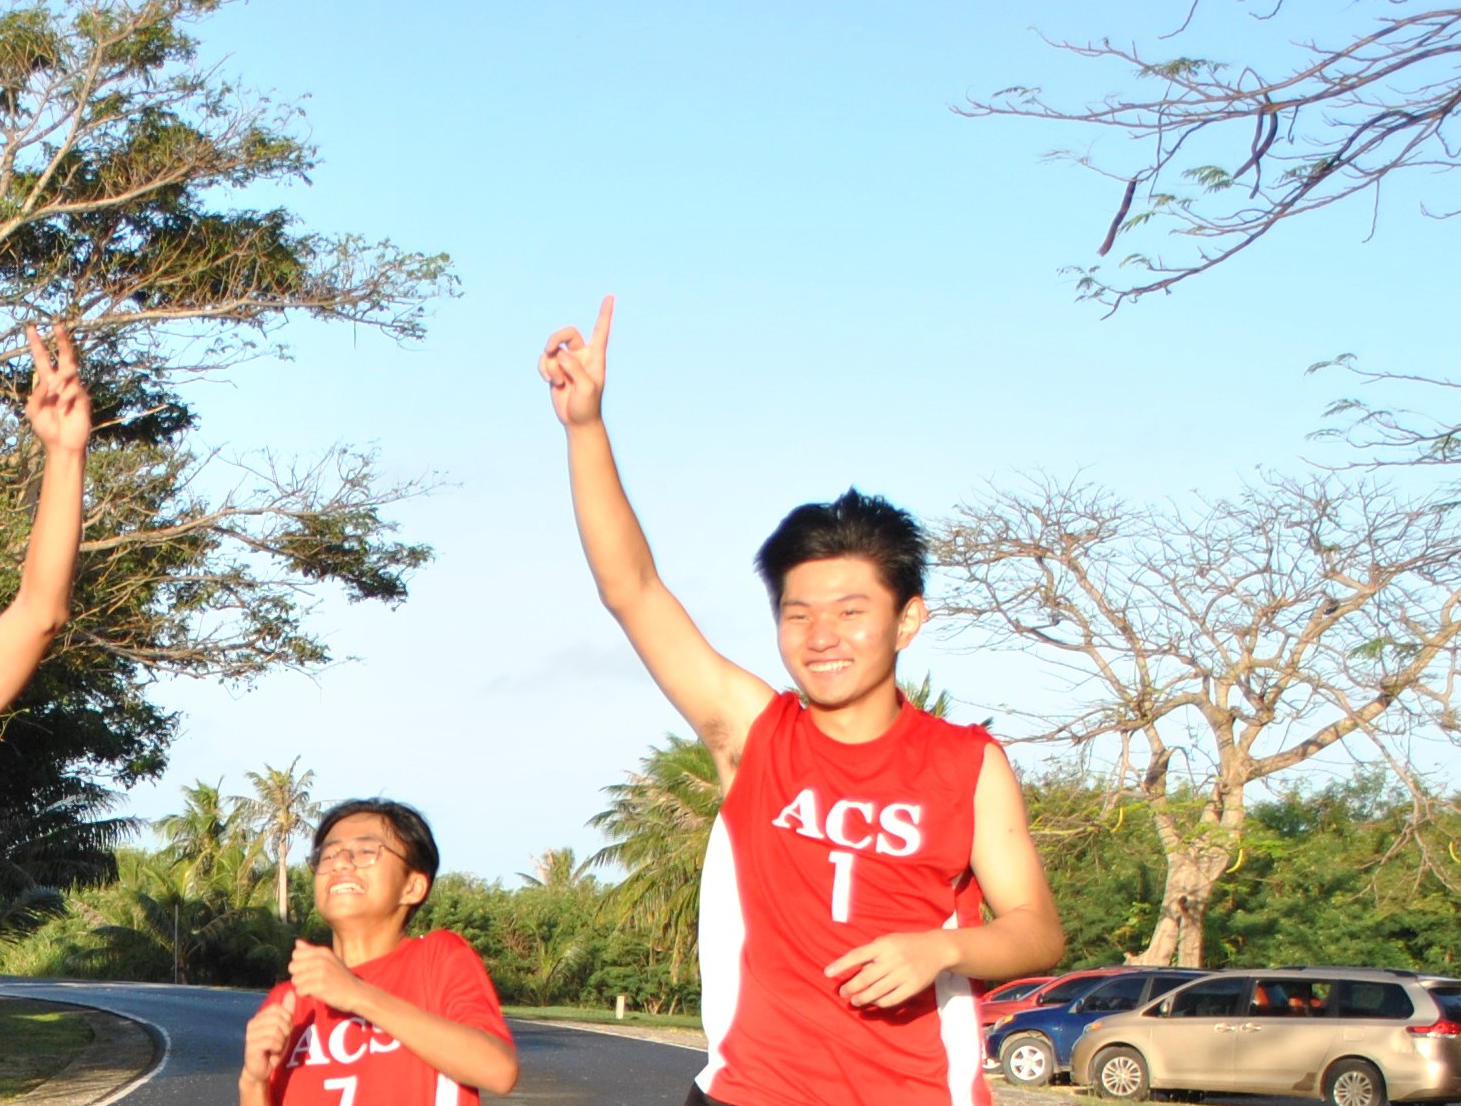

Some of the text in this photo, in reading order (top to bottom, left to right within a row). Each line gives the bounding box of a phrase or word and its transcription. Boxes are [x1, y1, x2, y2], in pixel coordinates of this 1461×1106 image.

[771, 788, 922, 857] ACS
[828, 851, 854, 923] 1
[286, 1016, 401, 1066] ACS
